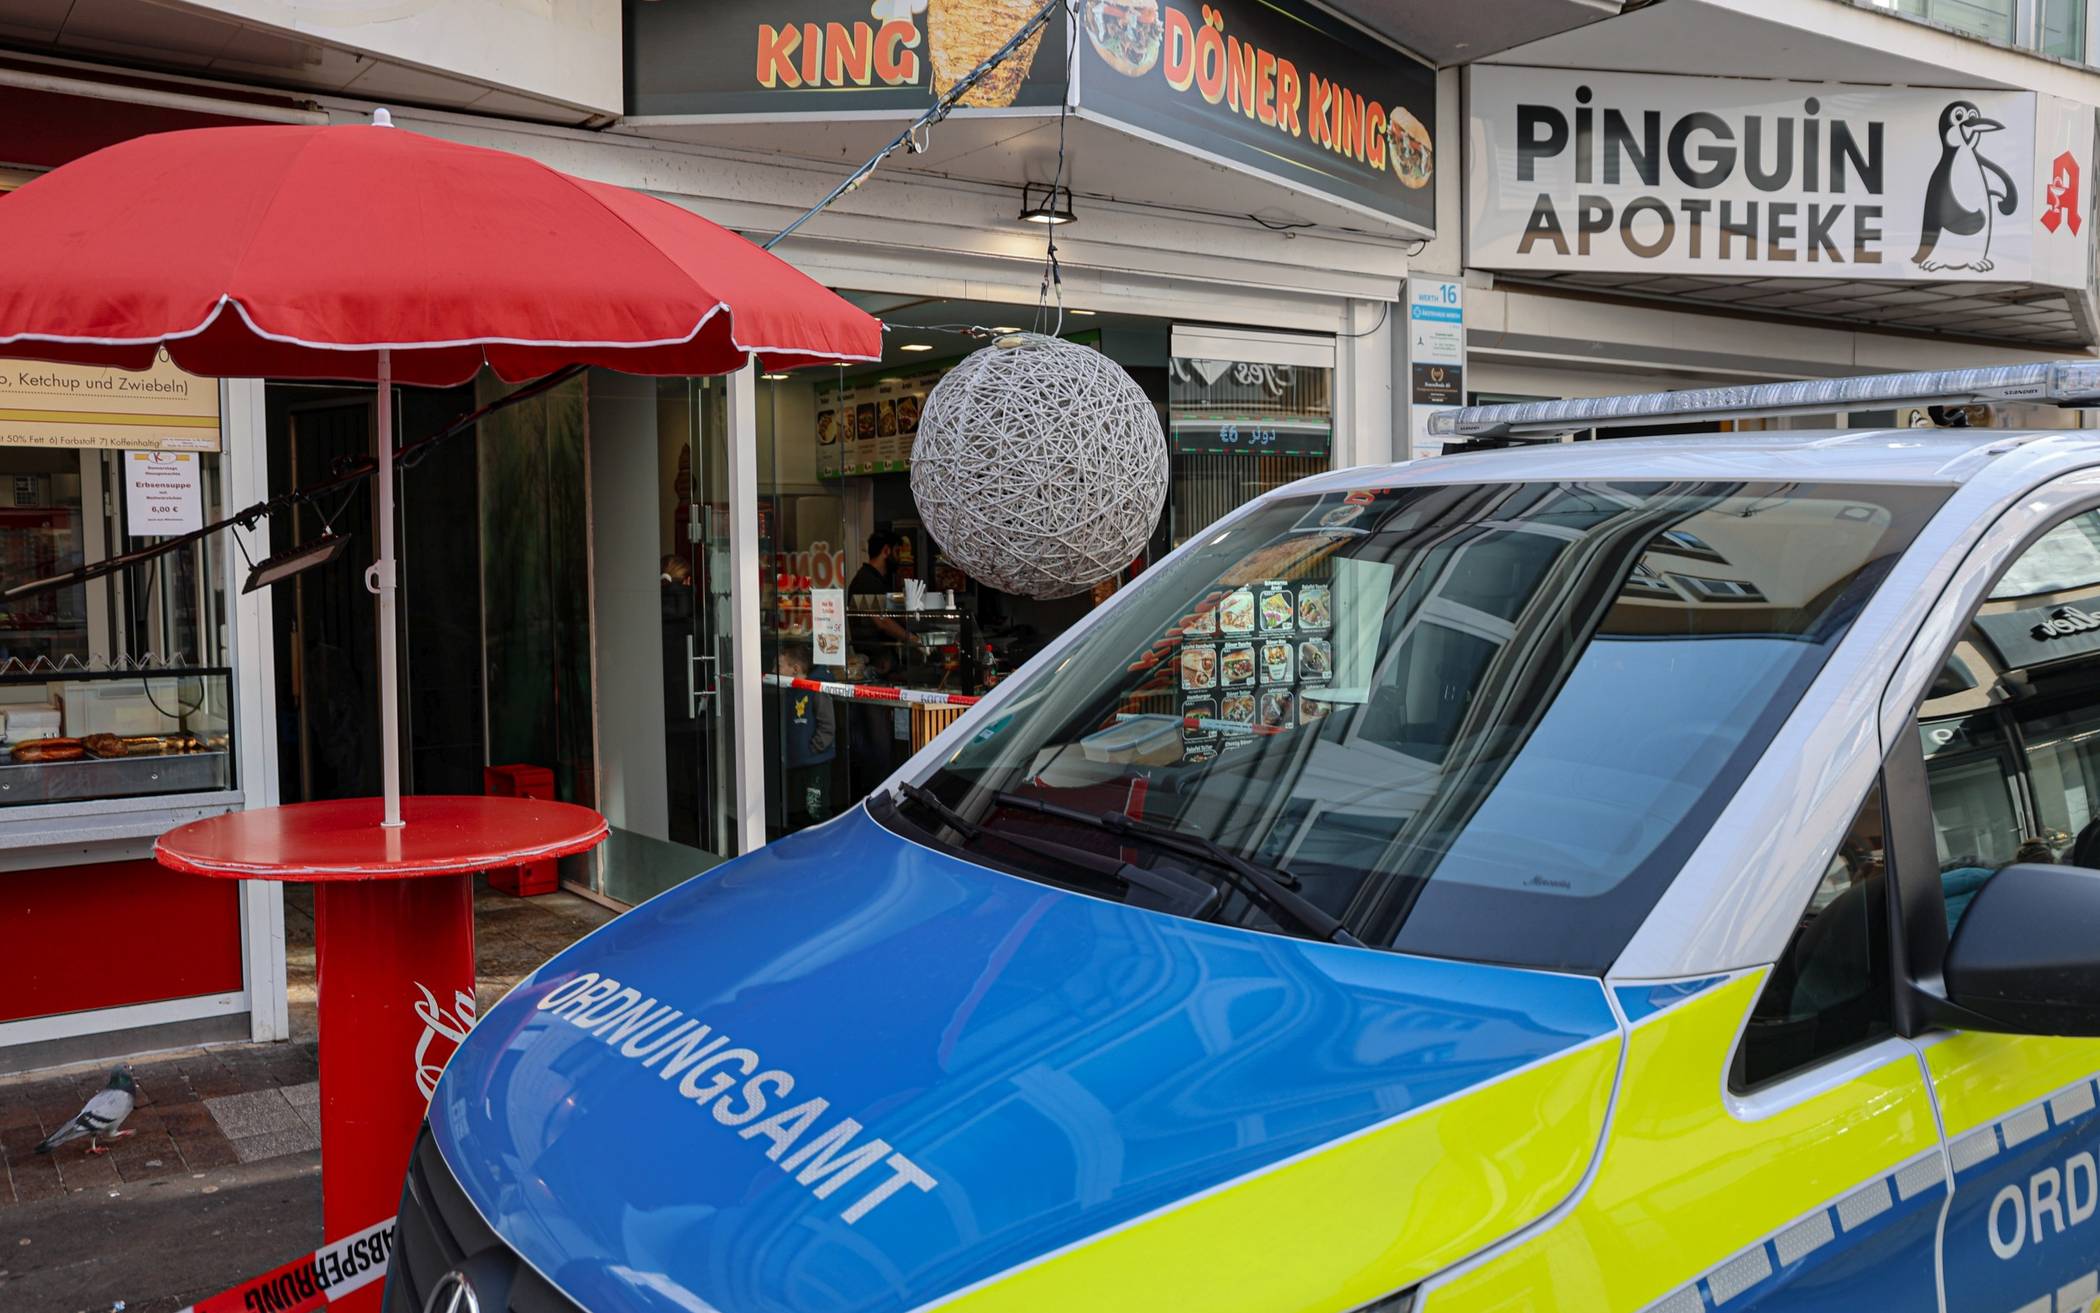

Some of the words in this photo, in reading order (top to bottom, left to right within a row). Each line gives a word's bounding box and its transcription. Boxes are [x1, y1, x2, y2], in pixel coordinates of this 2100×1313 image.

[757, 18, 919, 88] KING
[1163, 7, 1301, 137] DÖNER
[1308, 77, 1387, 169] KING
[1516, 193, 1883, 263] APOTHEKE
[1440, 284, 1457, 304] 16
[19, 372, 81, 390] Ketchup
[86, 376, 113, 389] und
[119, 377, 188, 395] Zwiebeln)
[7, 435, 26, 443] 50%
[29, 435, 44, 444] Fett
[50, 436, 58, 445] 6)
[61, 436, 96, 445] Farbstoff
[100, 437, 108, 446] 7)
[110, 438, 160, 449] Koffeinhaltig
[135, 481, 192, 490] Erbsensuppe
[537, 972, 938, 1225] ORDNUNGSAMT
[1987, 1151, 2098, 1260] ORD
